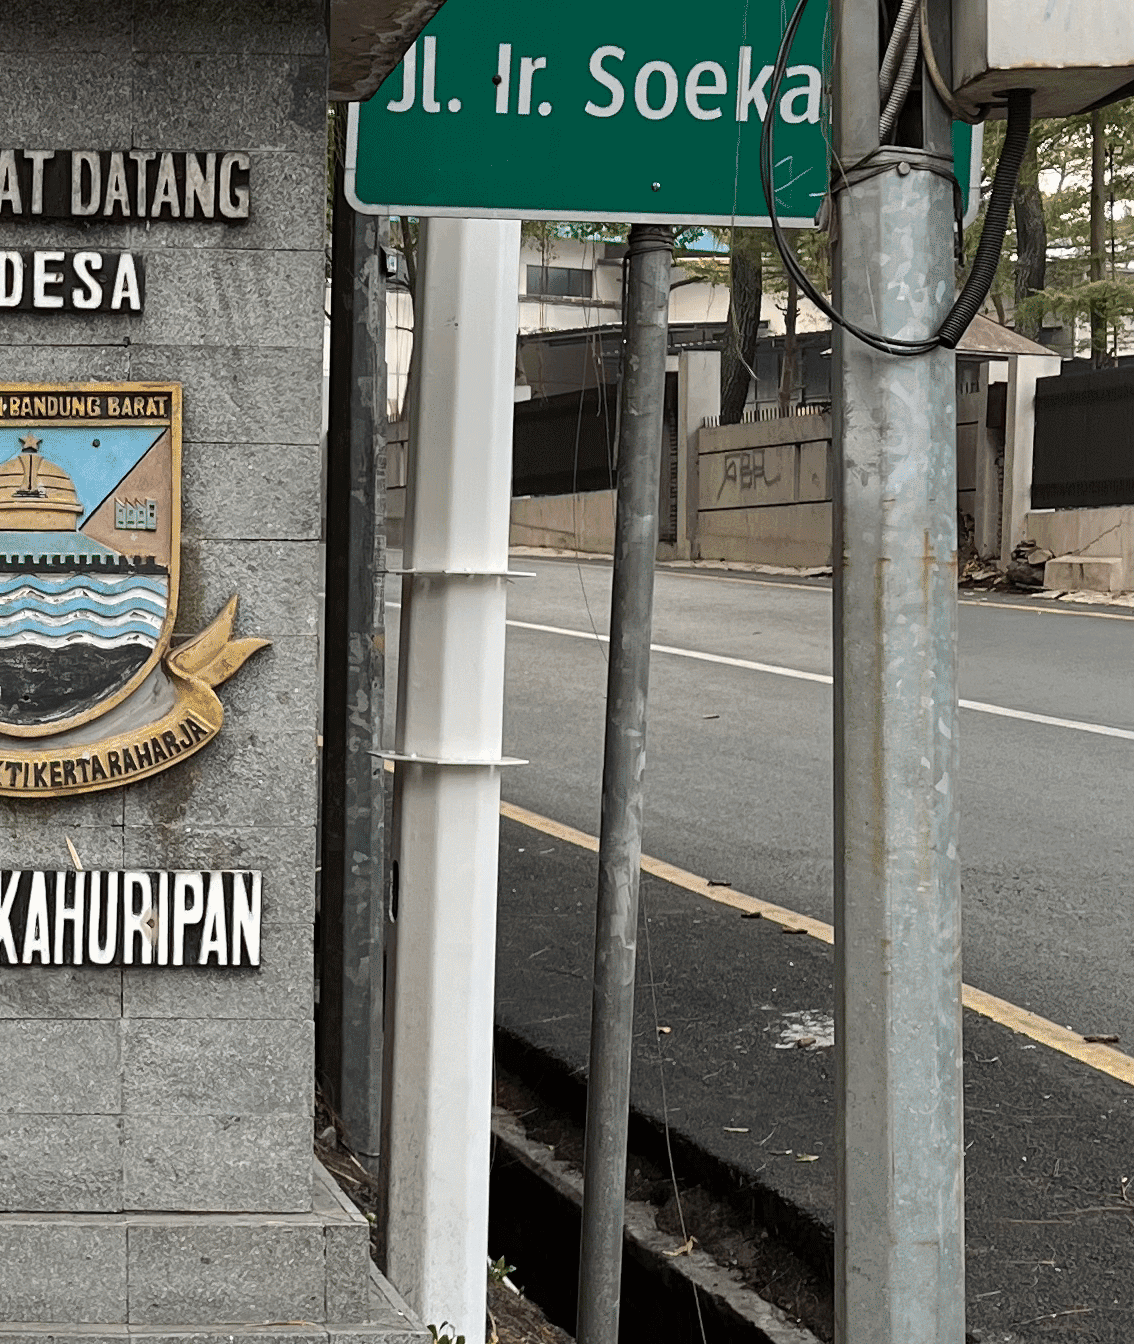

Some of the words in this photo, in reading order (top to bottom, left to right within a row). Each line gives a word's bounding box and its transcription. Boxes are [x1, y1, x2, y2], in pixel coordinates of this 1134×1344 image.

[387, 35, 462, 115] Jl.
[494, 42, 552, 117] Ir.
[584, 44, 833, 125] Soeka
[71, 151, 250, 219] DATANG
[10, 395, 101, 417] BANDUNG
[107, 395, 168, 417] BARAT
